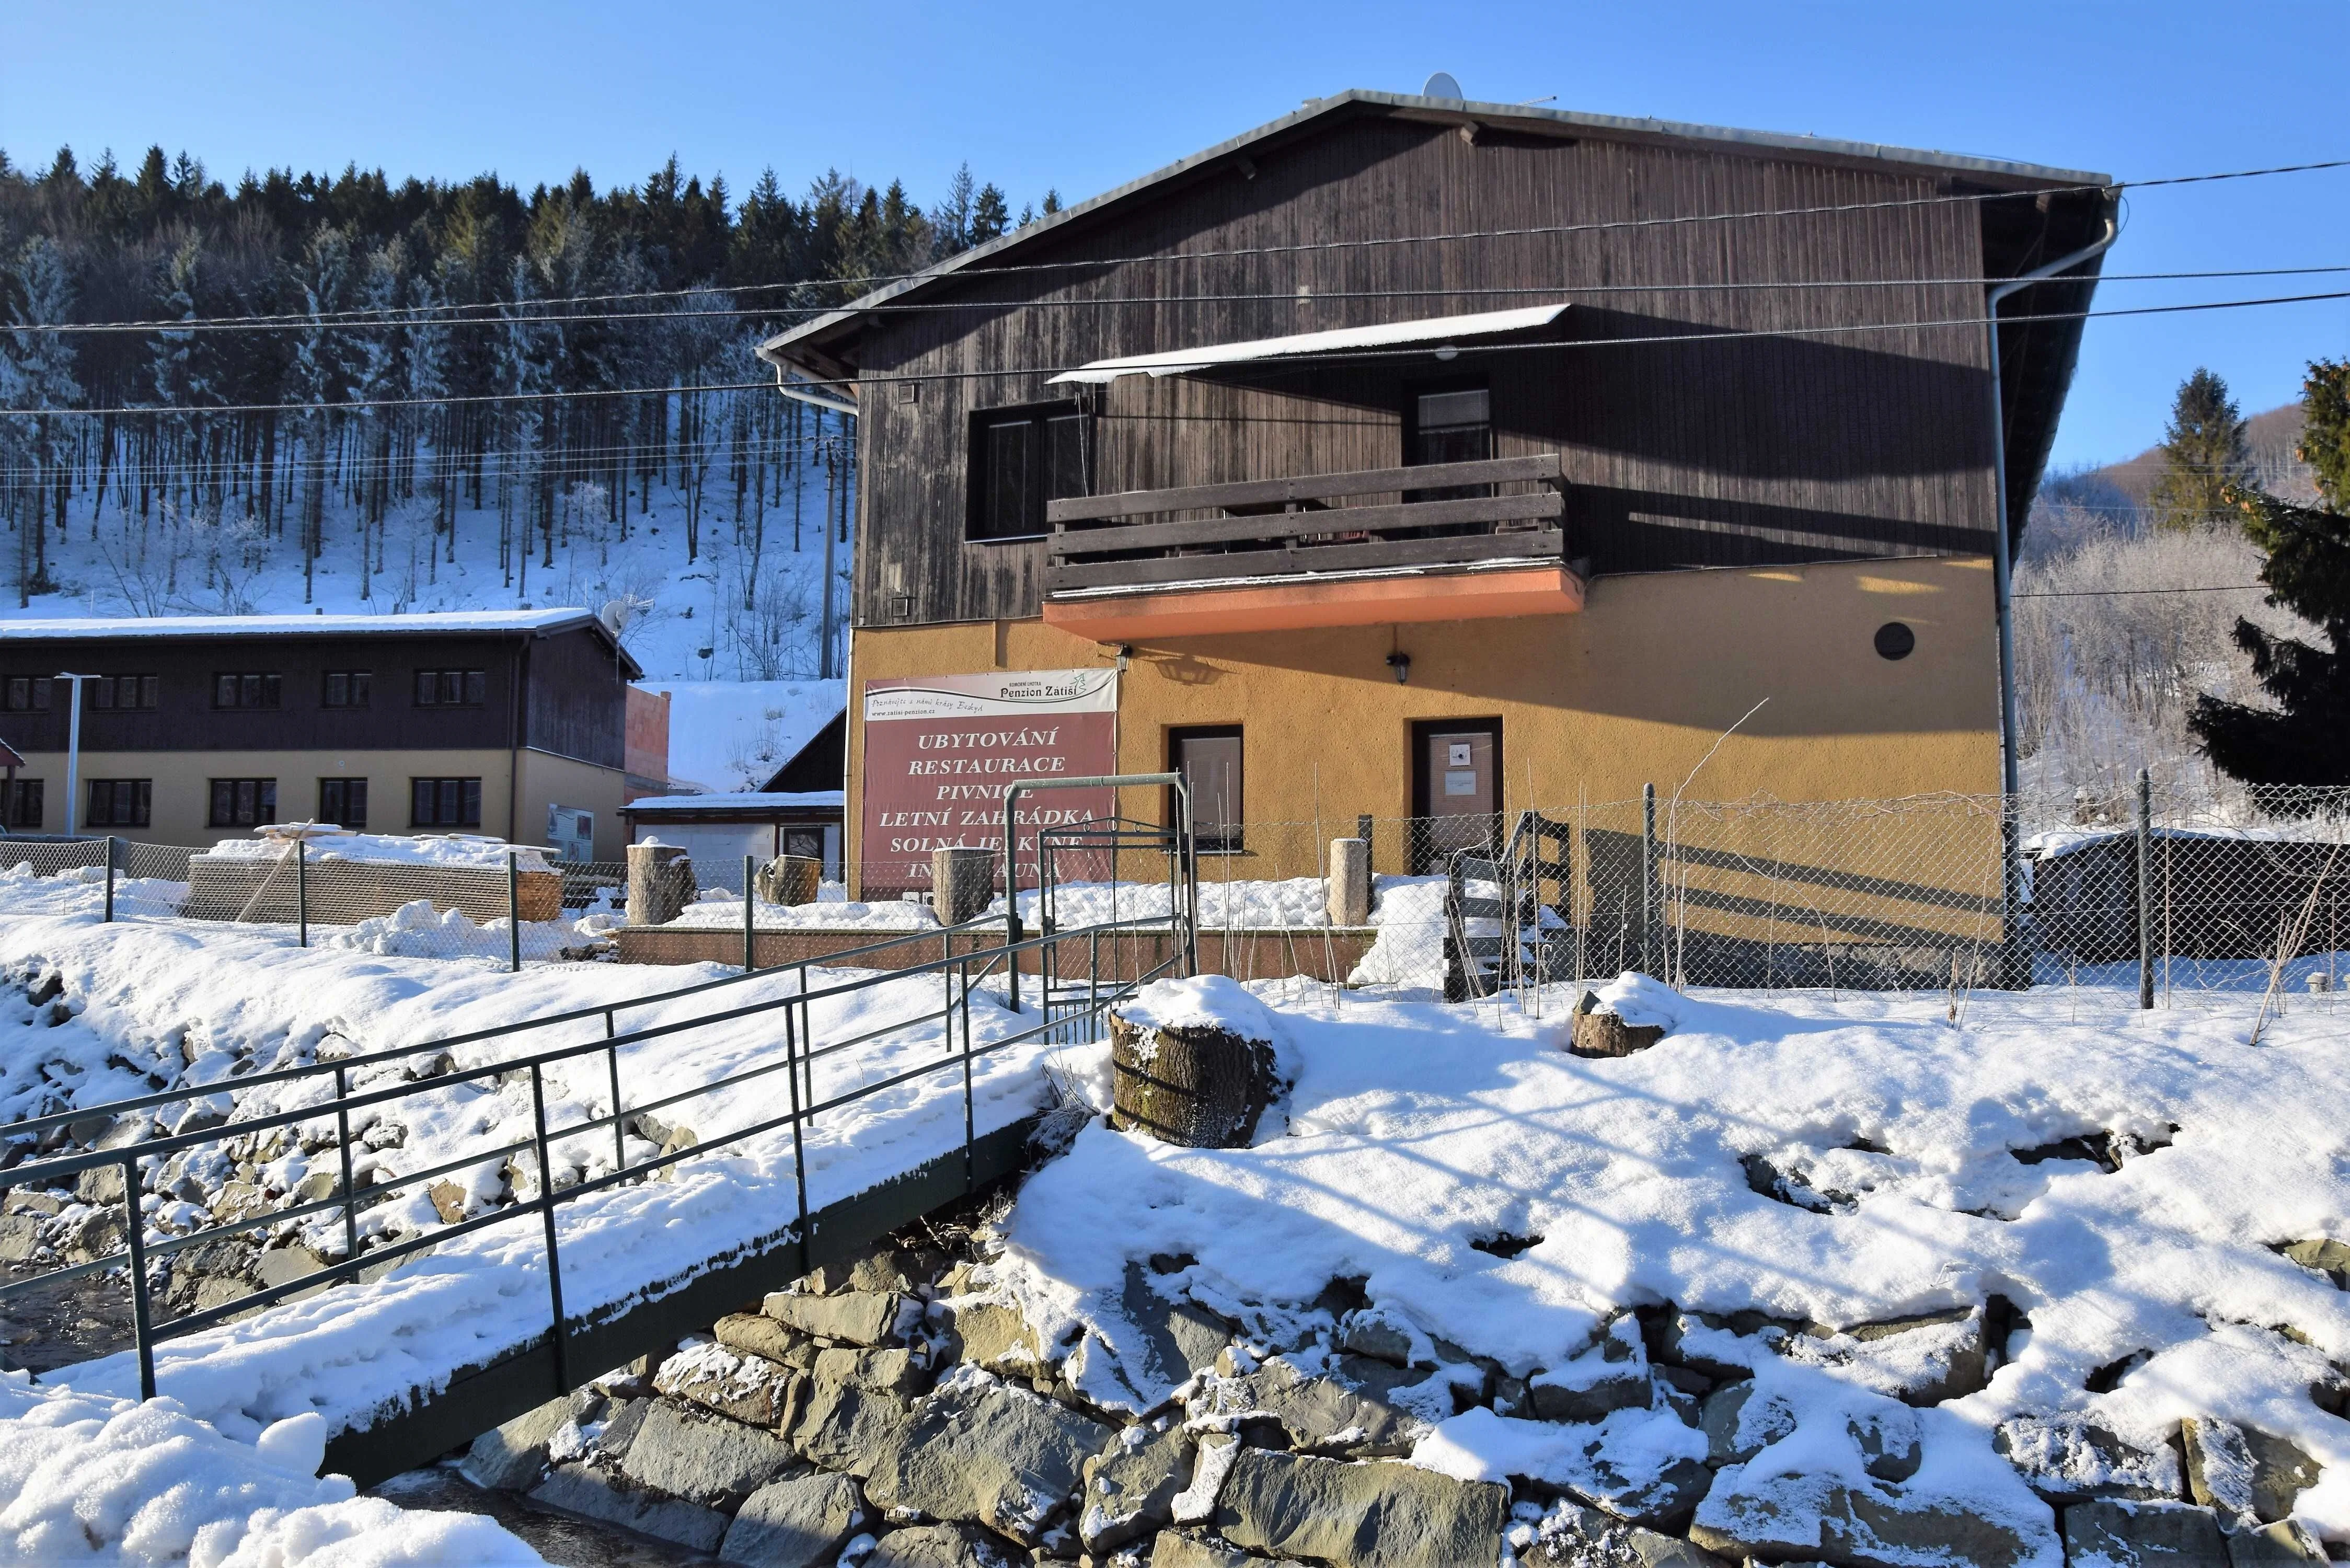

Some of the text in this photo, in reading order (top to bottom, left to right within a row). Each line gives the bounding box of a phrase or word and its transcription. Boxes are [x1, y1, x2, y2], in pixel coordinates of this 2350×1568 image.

[1000, 686, 1077, 698] Penzion Zátiší
[936, 698, 953, 710] krásy
[957, 701, 983, 713] Beskyd
[918, 727, 1059, 749] UBYTOVÁNÍ
[908, 757, 1065, 775] RESTAURACE
[880, 806, 1095, 827] LETNÍ ZAHRÁDKA
[891, 833, 966, 852] SOLNÁ
